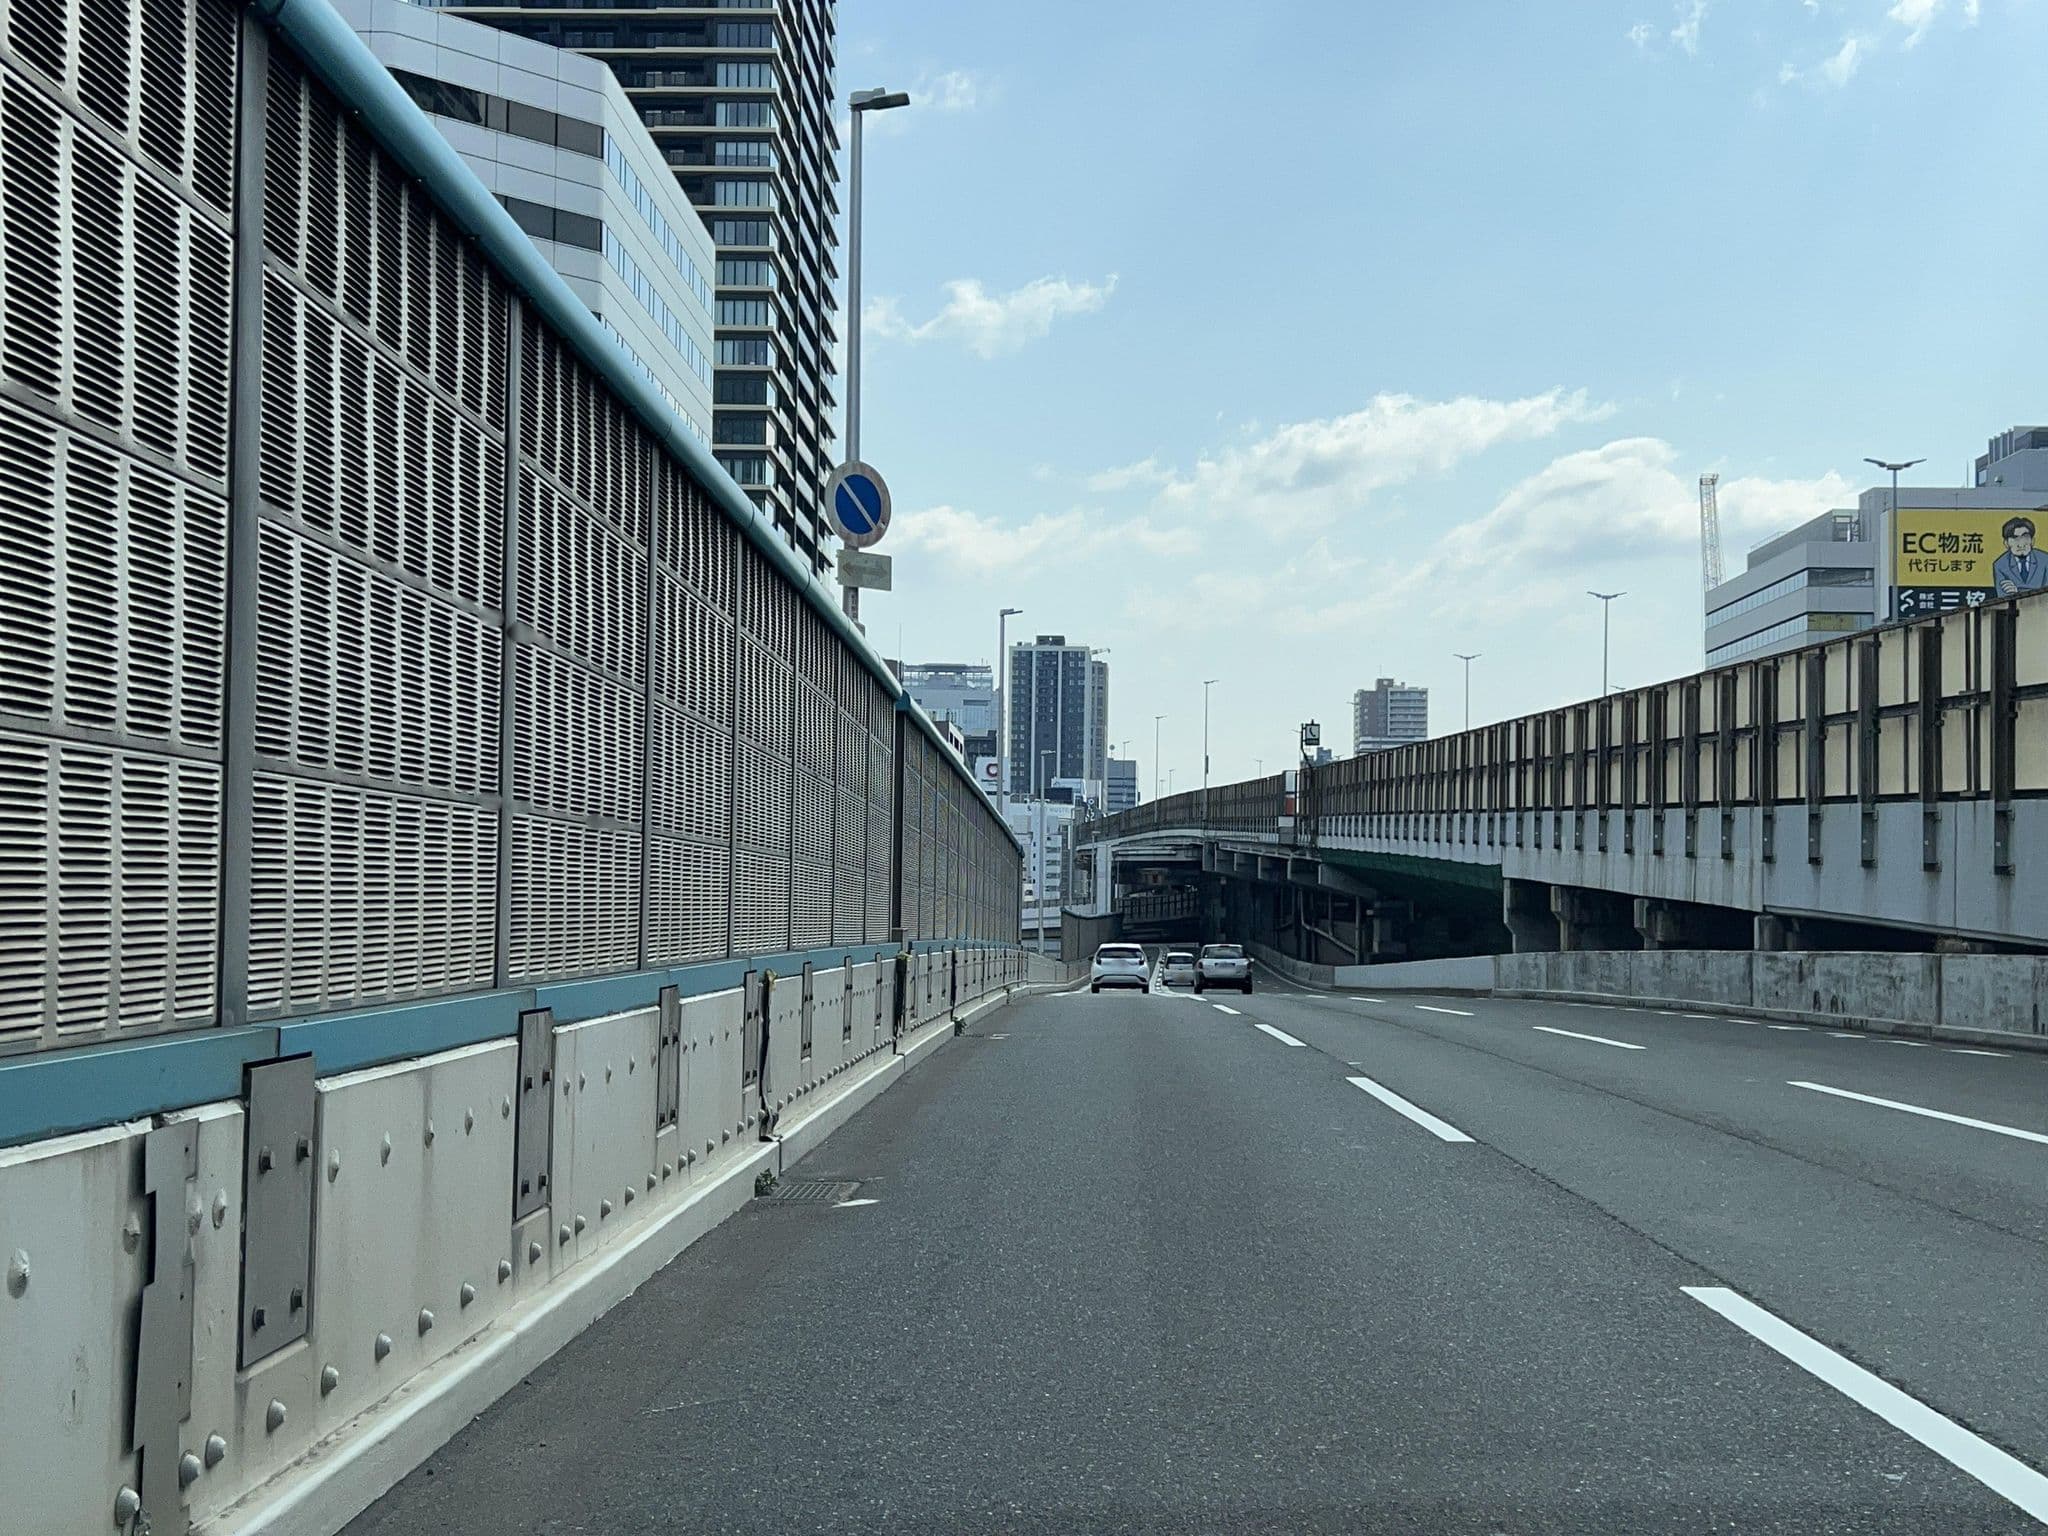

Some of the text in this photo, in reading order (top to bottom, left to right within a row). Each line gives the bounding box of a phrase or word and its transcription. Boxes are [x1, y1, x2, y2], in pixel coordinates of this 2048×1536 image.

[1902, 532, 1984, 554] EC物流
[1908, 558, 1977, 572] 代行します
